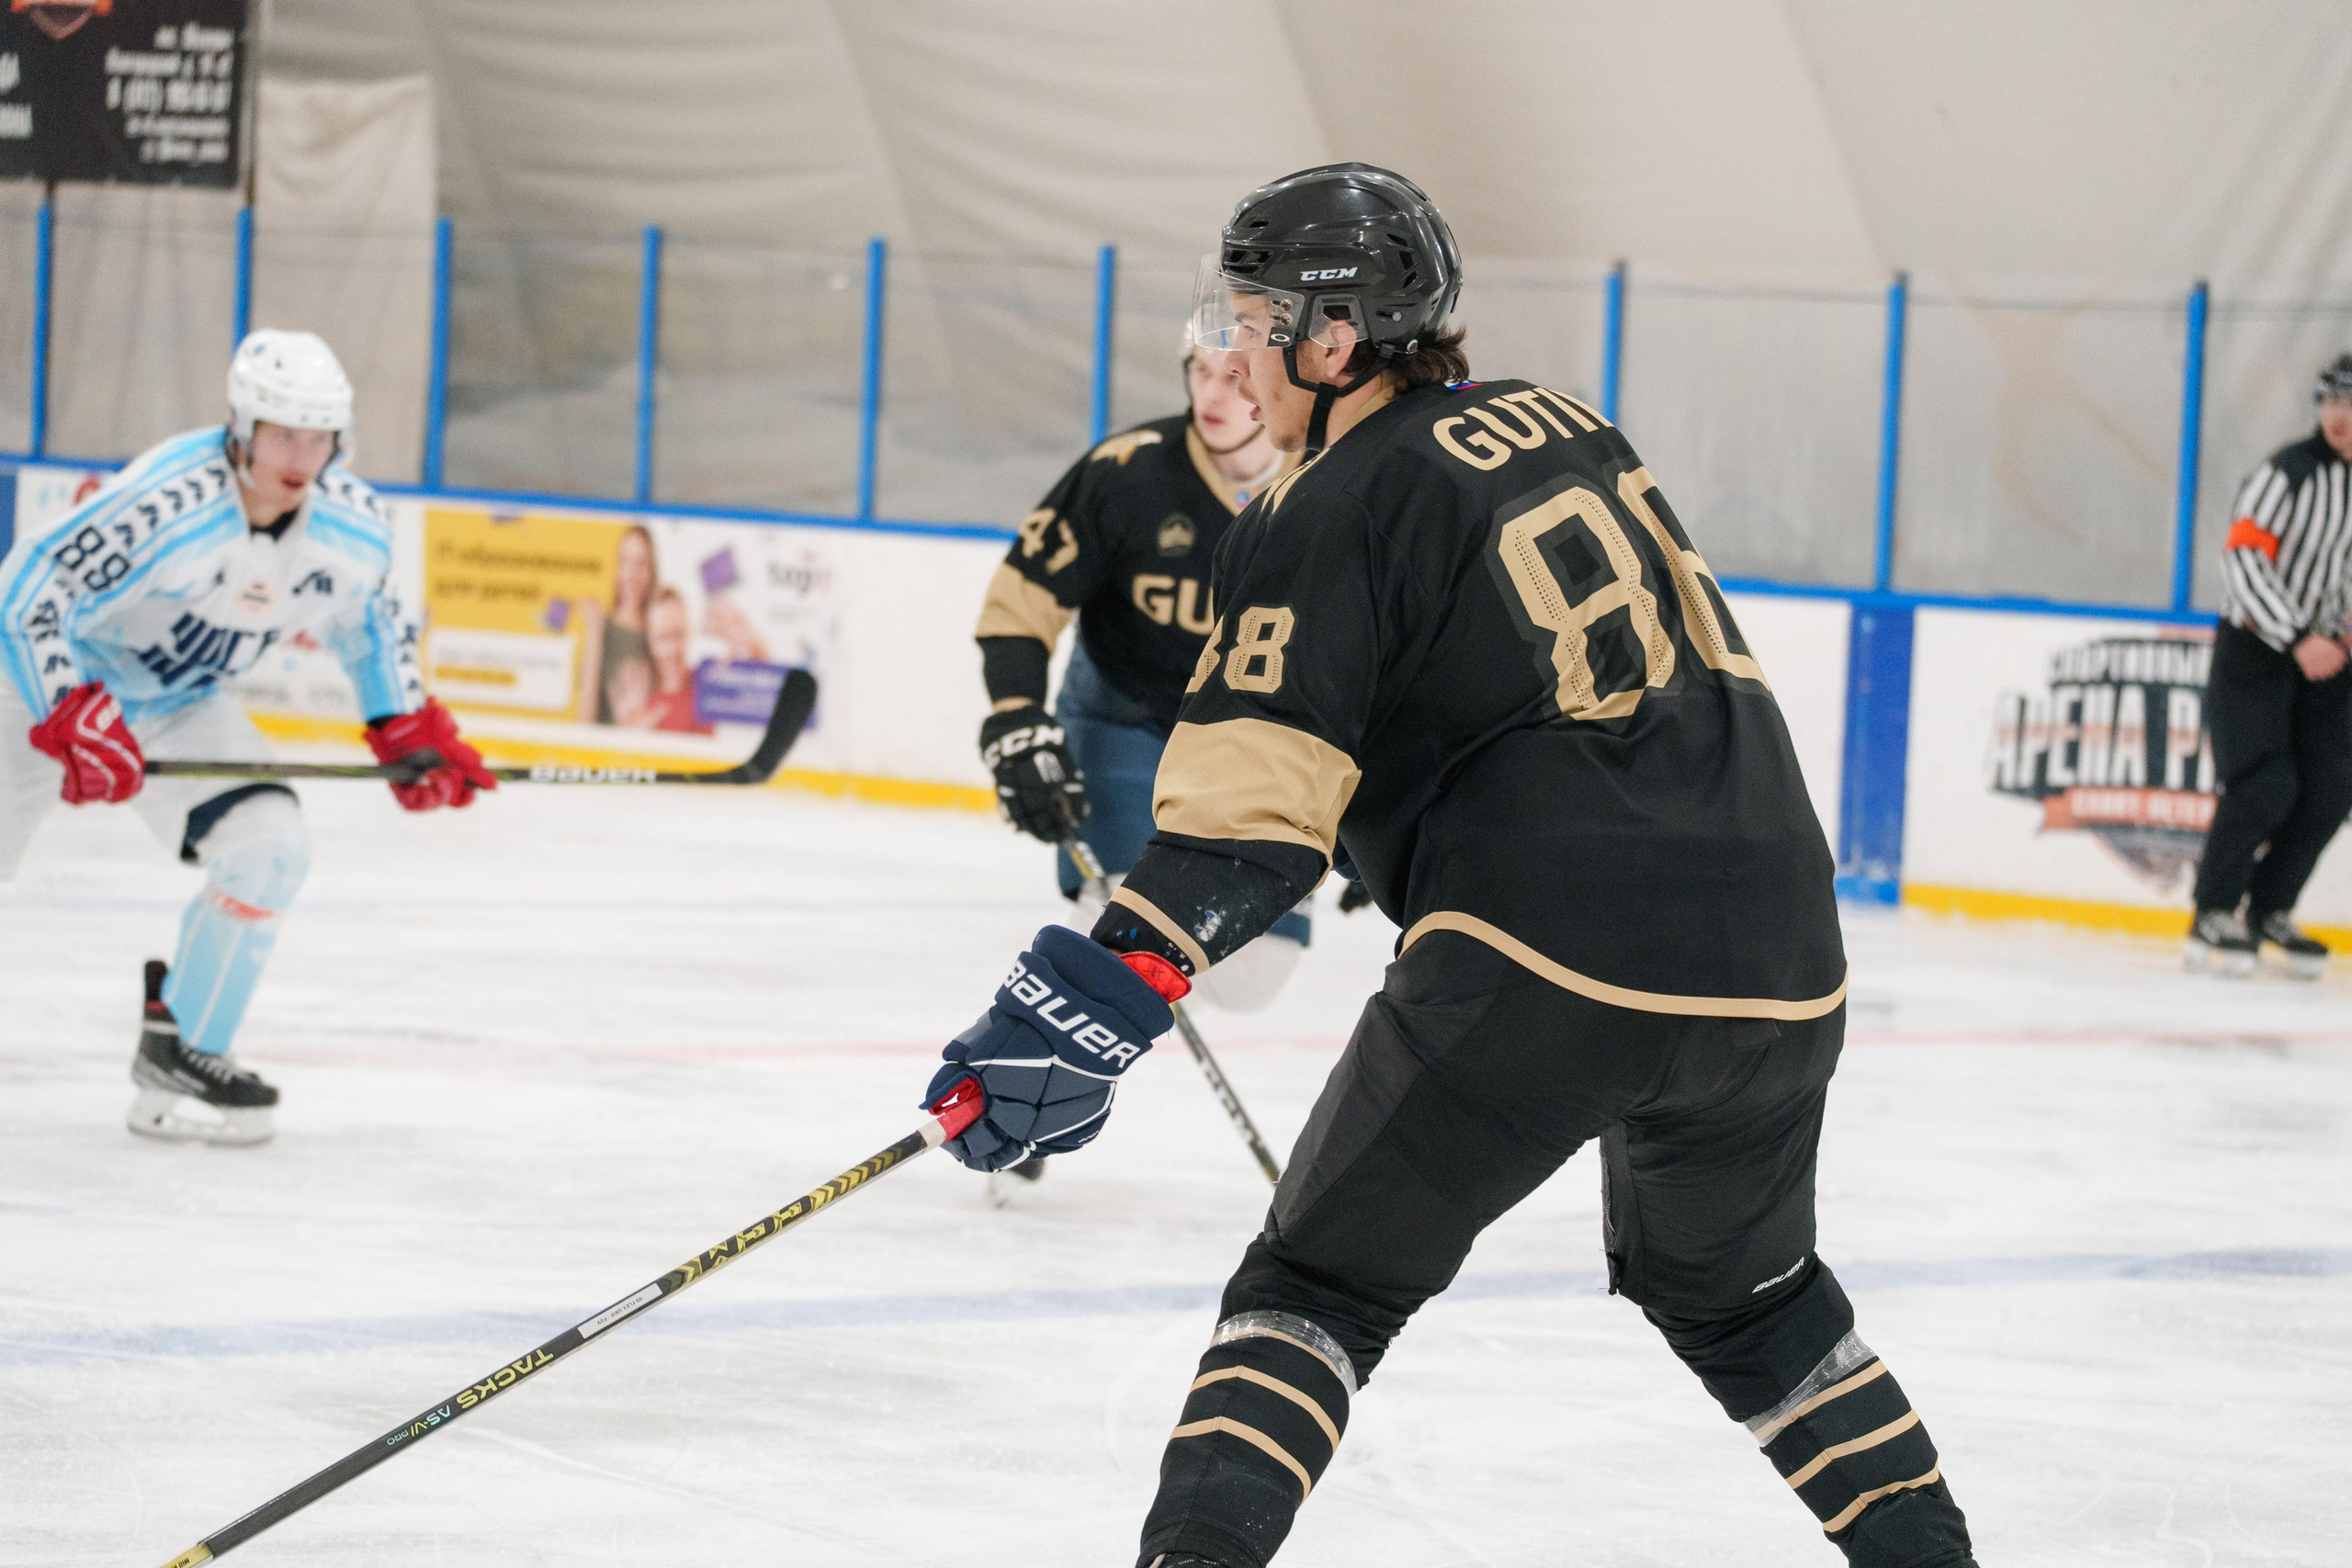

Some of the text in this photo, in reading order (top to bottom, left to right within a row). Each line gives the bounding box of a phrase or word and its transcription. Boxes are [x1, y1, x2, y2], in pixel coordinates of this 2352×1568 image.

[1300, 266, 1358, 282] CCM
[983, 724, 1066, 769] CCM
[1003, 959, 1141, 1068] BAUER
[699, 1195, 812, 1273] CCM
[1751, 1256, 1805, 1294] BAUER
[457, 1348, 554, 1409] TACKS
[387, 1429, 409, 1446] PRO
